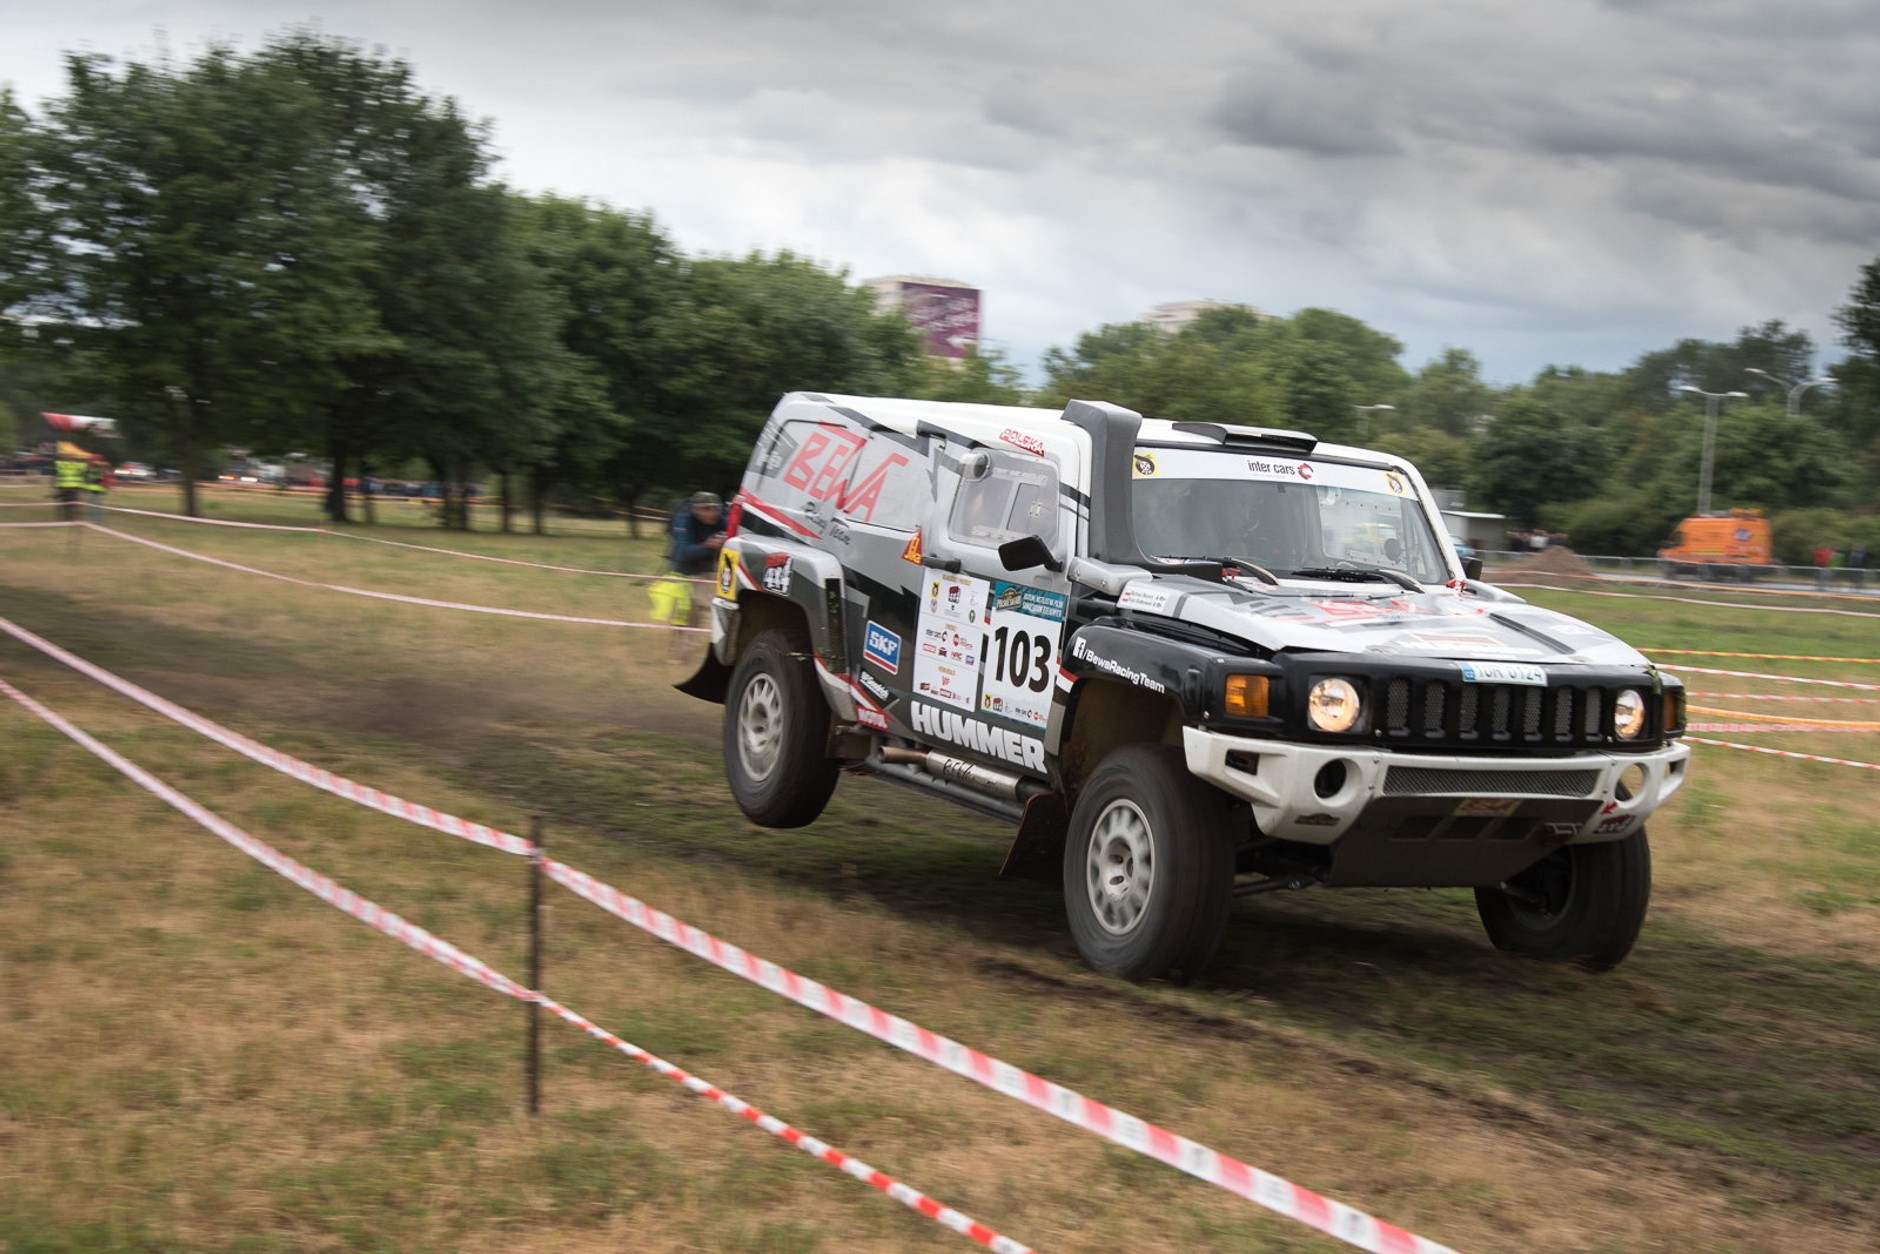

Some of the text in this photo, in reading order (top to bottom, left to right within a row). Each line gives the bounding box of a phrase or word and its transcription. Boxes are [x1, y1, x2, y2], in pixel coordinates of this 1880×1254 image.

[783, 421, 909, 523] BEWA
[1247, 460, 1296, 475] inter cars
[869, 631, 898, 656] SKF
[995, 625, 1051, 693] 103
[911, 701, 1048, 774] HUMMER
